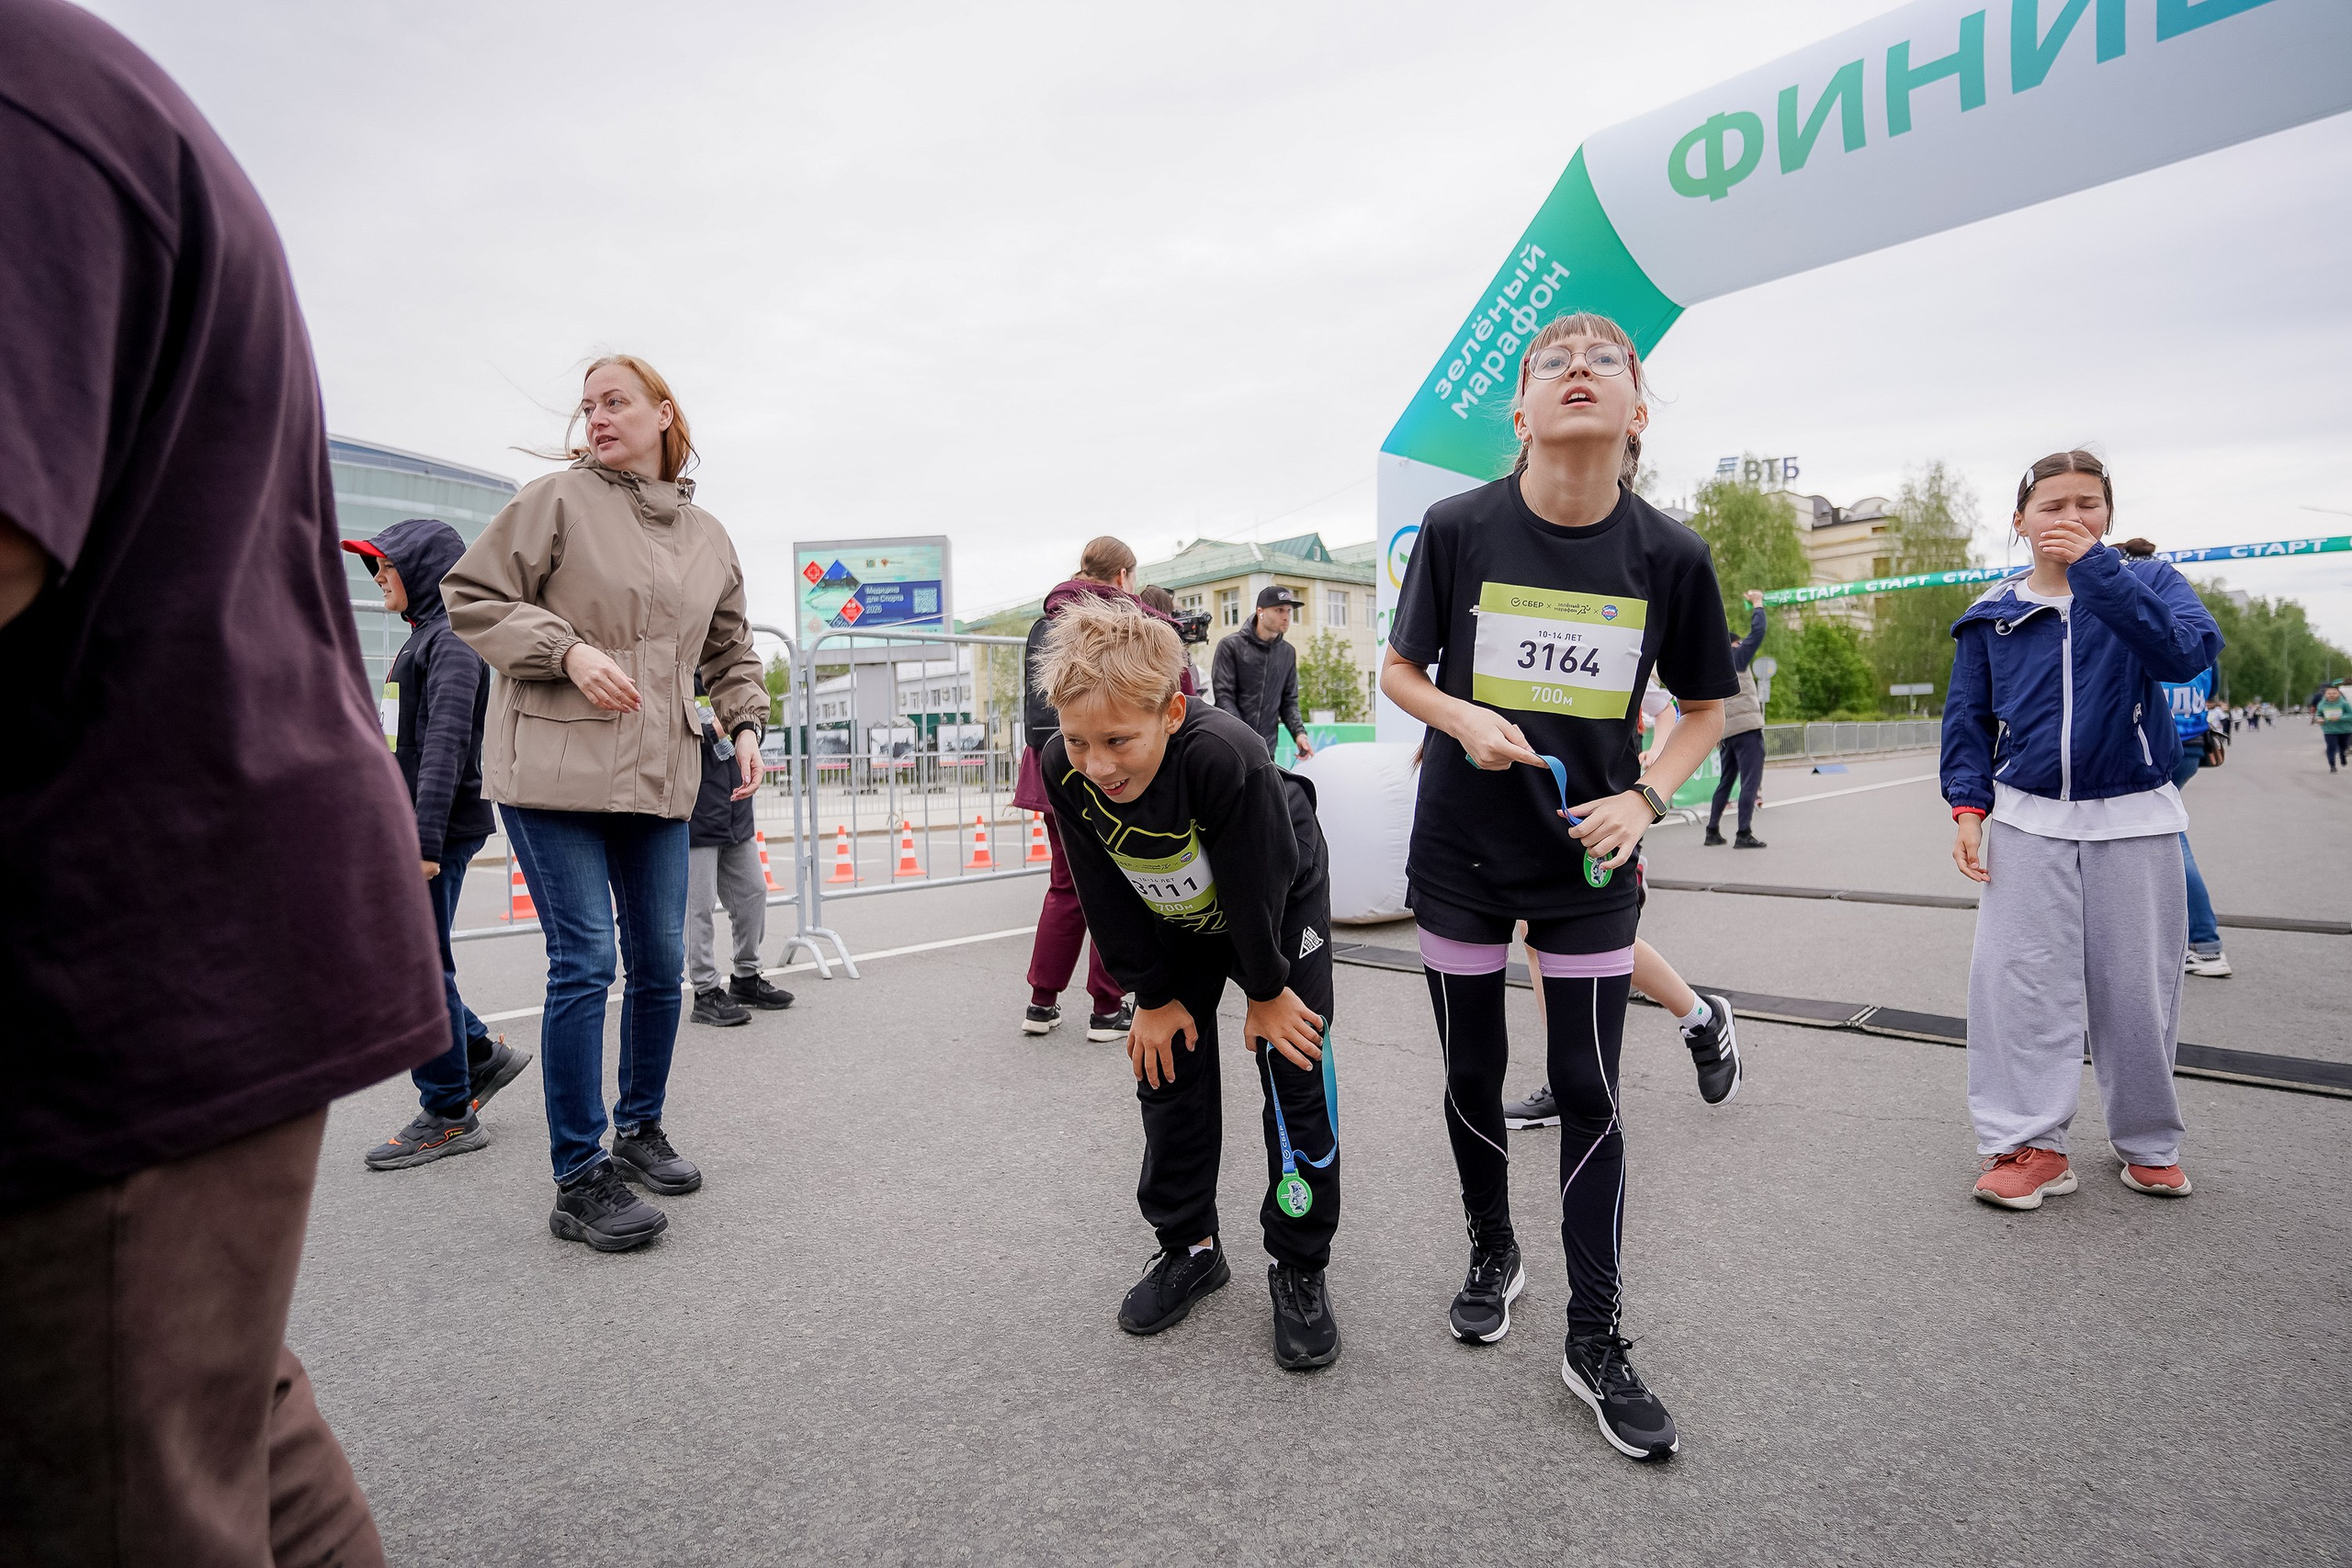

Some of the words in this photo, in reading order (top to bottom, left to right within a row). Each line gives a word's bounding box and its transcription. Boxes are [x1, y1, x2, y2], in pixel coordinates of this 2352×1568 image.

[1434, 243, 1546, 400] зелёный
[1451, 260, 1571, 420] марафон
[1744, 457, 1799, 482] ВТБ
[1795, 583, 1854, 603] СТАРТ
[1864, 575, 1929, 592] СТАРТ
[1942, 567, 2015, 583] СТАРТ
[2230, 538, 2328, 558] СТАРТ
[1521, 600, 1544, 609] СБЕР
[1538, 630, 1562, 640] 10-14
[1565, 634, 1583, 642] ЛЕТ
[1517, 640, 1600, 677] 3164
[1132, 876, 1198, 898] 3111
